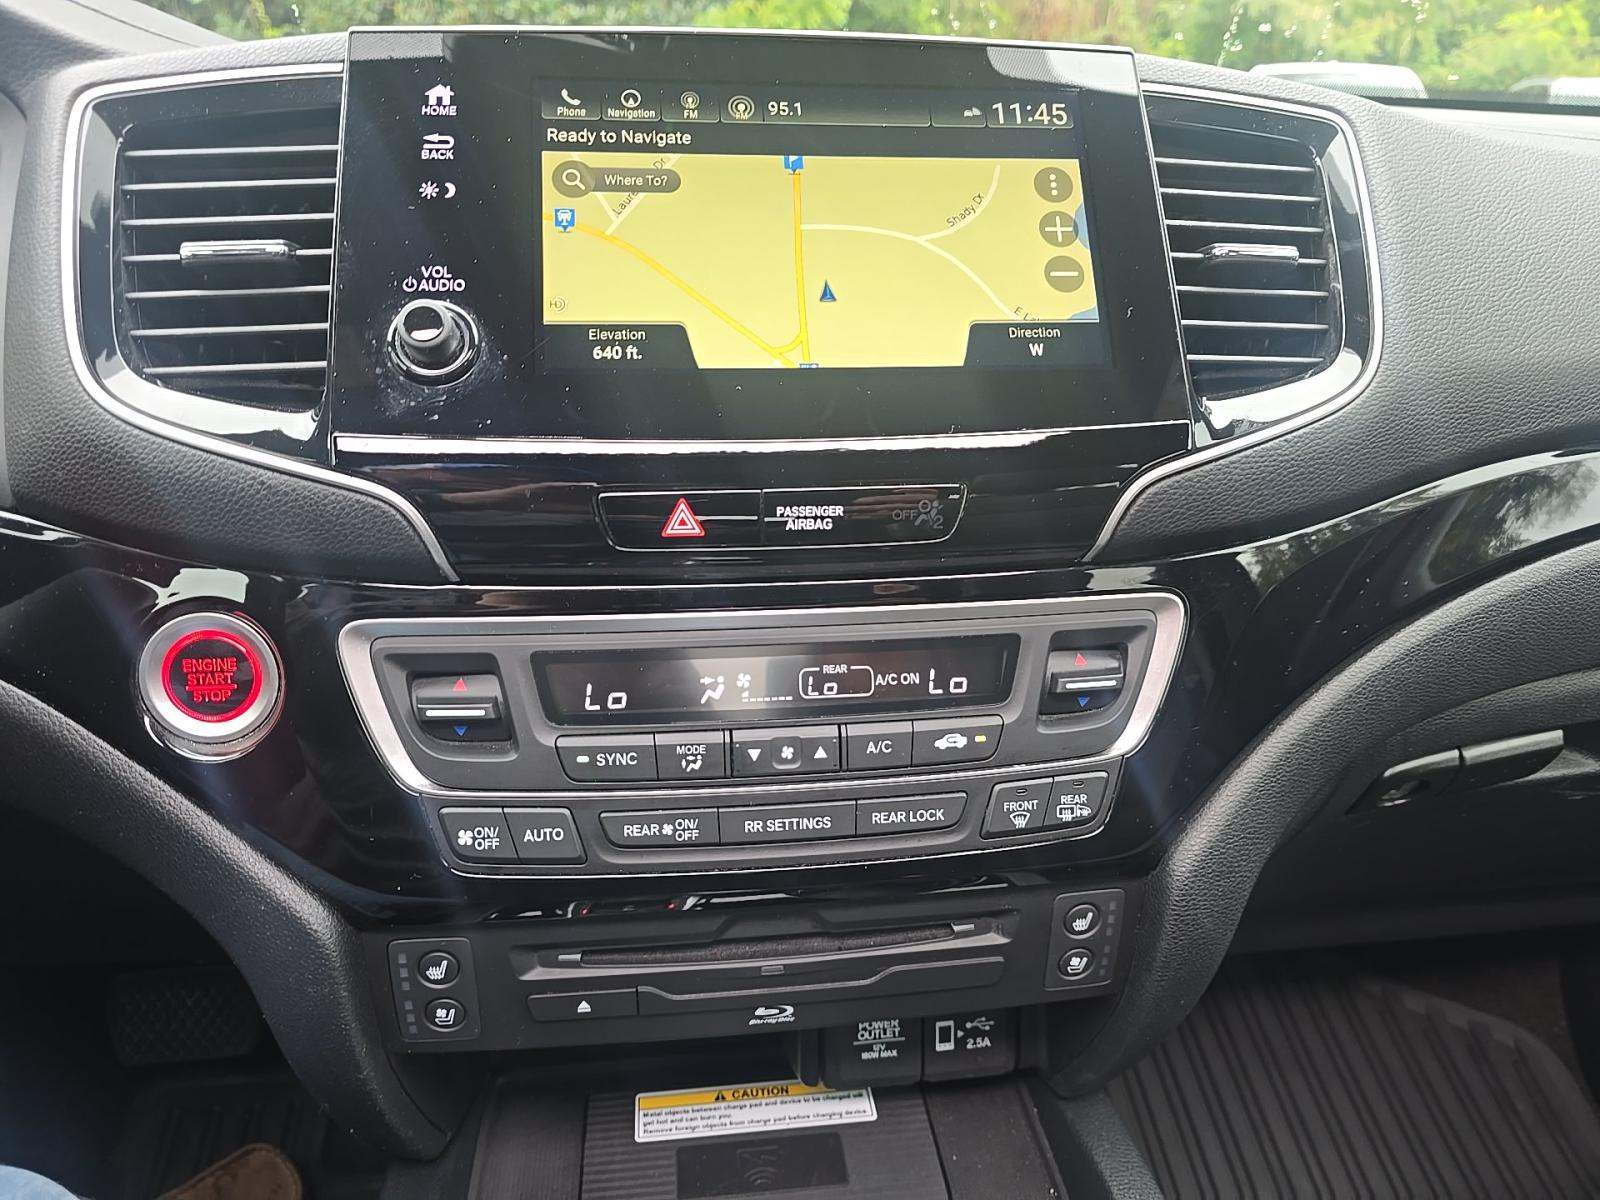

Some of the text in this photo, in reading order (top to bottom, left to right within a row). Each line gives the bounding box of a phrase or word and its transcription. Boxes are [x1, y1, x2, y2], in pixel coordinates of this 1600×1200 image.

[421, 105, 457, 116] HOME
[557, 107, 586, 117] Phone
[607, 108, 656, 119] Navigation
[683, 109, 698, 119] FM
[767, 101, 802, 116] 95.1
[992, 102, 1068, 125] 11:45
[546, 128, 692, 147] Ready to Navigate
[421, 149, 454, 160] BACK
[604, 174, 668, 186] Where To?
[946, 204, 976, 227] Shady
[421, 265, 452, 278] VOL
[418, 278, 466, 292] AUDIO
[588, 328, 646, 341] Elevation
[1008, 327, 1061, 338] Direction
[592, 345, 643, 360] 640 ft.
[1029, 343, 1044, 357] W
[776, 505, 844, 518] PASSENGER
[892, 509, 918, 521] OFF
[785, 518, 833, 531] AIRBAG
[182, 657, 238, 672] ENGINE
[823, 664, 848, 674] REAR
[187, 673, 234, 686] START
[875, 672, 920, 686] A/C ON
[928, 668, 968, 694] Lo
[808, 676, 838, 696] Lo
[193, 689, 231, 703] STOP
[584, 682, 628, 711] Lo
[676, 744, 707, 755] MODE
[866, 741, 893, 754] A/C
[596, 752, 638, 767] SYNC
[1003, 800, 1038, 812] FRONT
[1060, 794, 1088, 805] REAR
[872, 808, 945, 824] REAR LOCK
[623, 824, 660, 837] REAR
[674, 818, 698, 830] ON/
[744, 817, 832, 833] RR SETTINGS
[474, 826, 499, 839] ON/
[523, 828, 564, 842] AUTO
[675, 829, 700, 842] OFF
[474, 838, 500, 850] OFF
[859, 1019, 900, 1031] POWER
[857, 1027, 901, 1041] OUTLET
[966, 1037, 992, 1049] 2.5A
[880, 1049, 898, 1058] MAX
[731, 1085, 790, 1100] CAUTION
